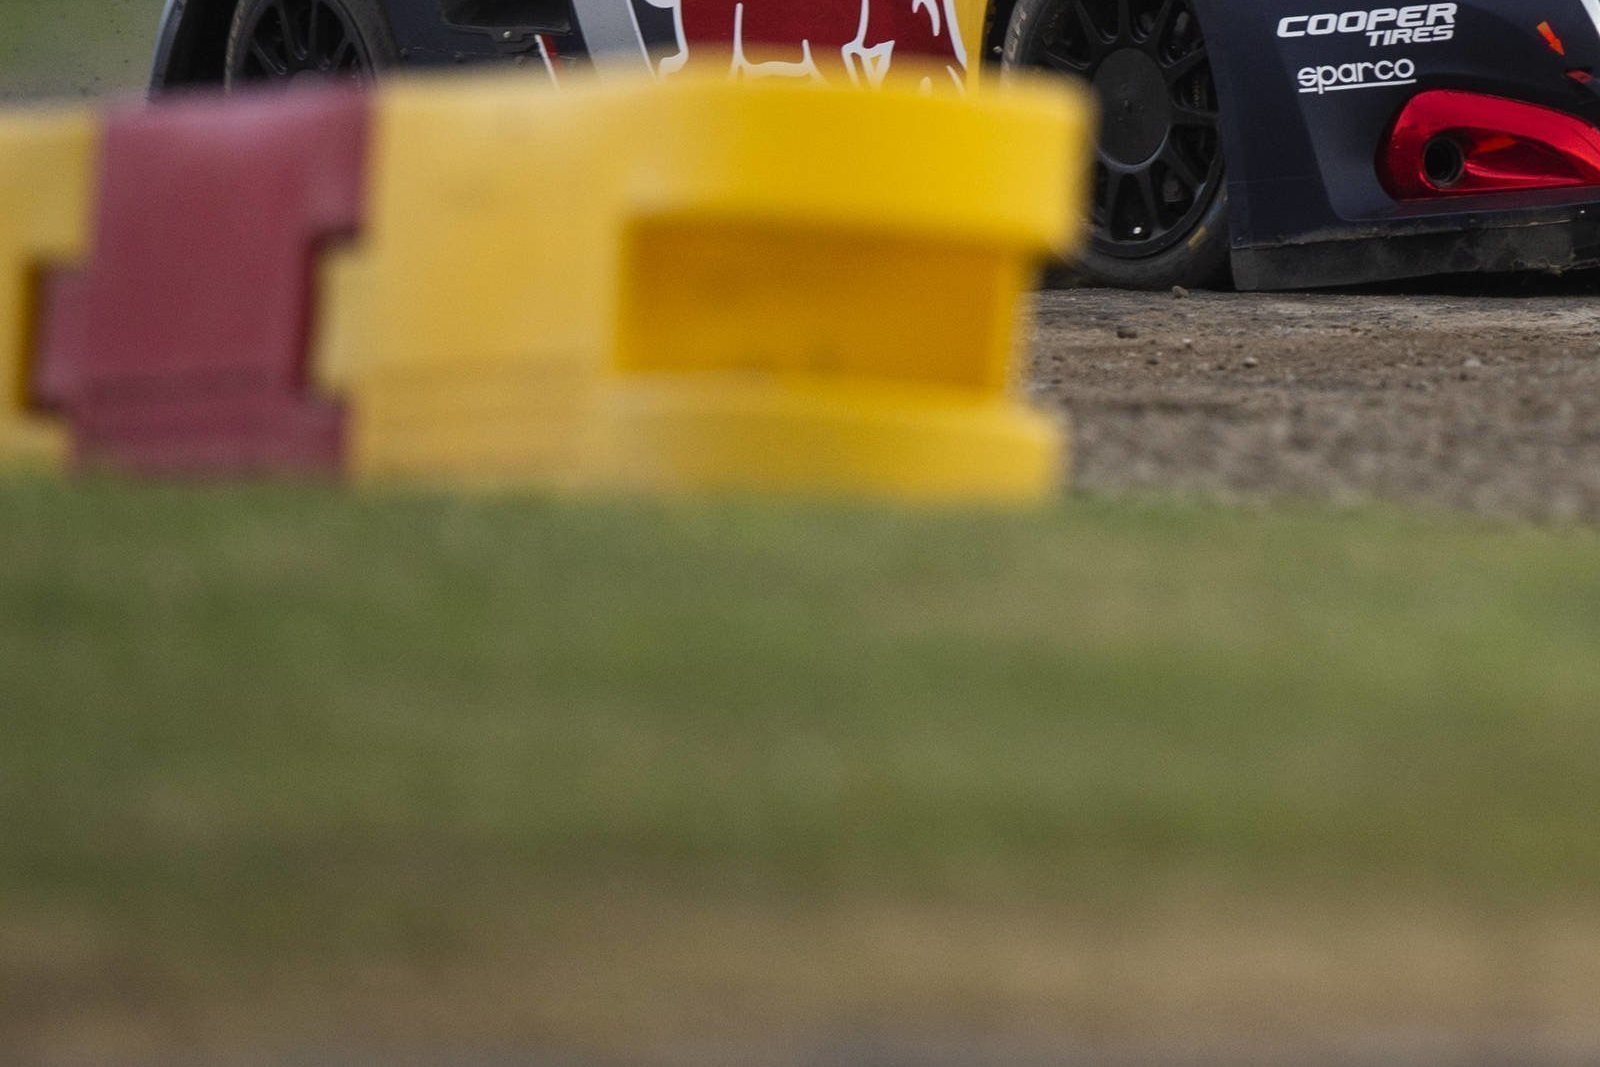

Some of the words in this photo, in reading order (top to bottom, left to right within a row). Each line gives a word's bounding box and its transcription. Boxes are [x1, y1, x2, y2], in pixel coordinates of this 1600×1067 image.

[1276, 2, 1459, 38] COOPER
[1364, 24, 1455, 47] TIRES
[1296, 58, 1417, 95] sparco
